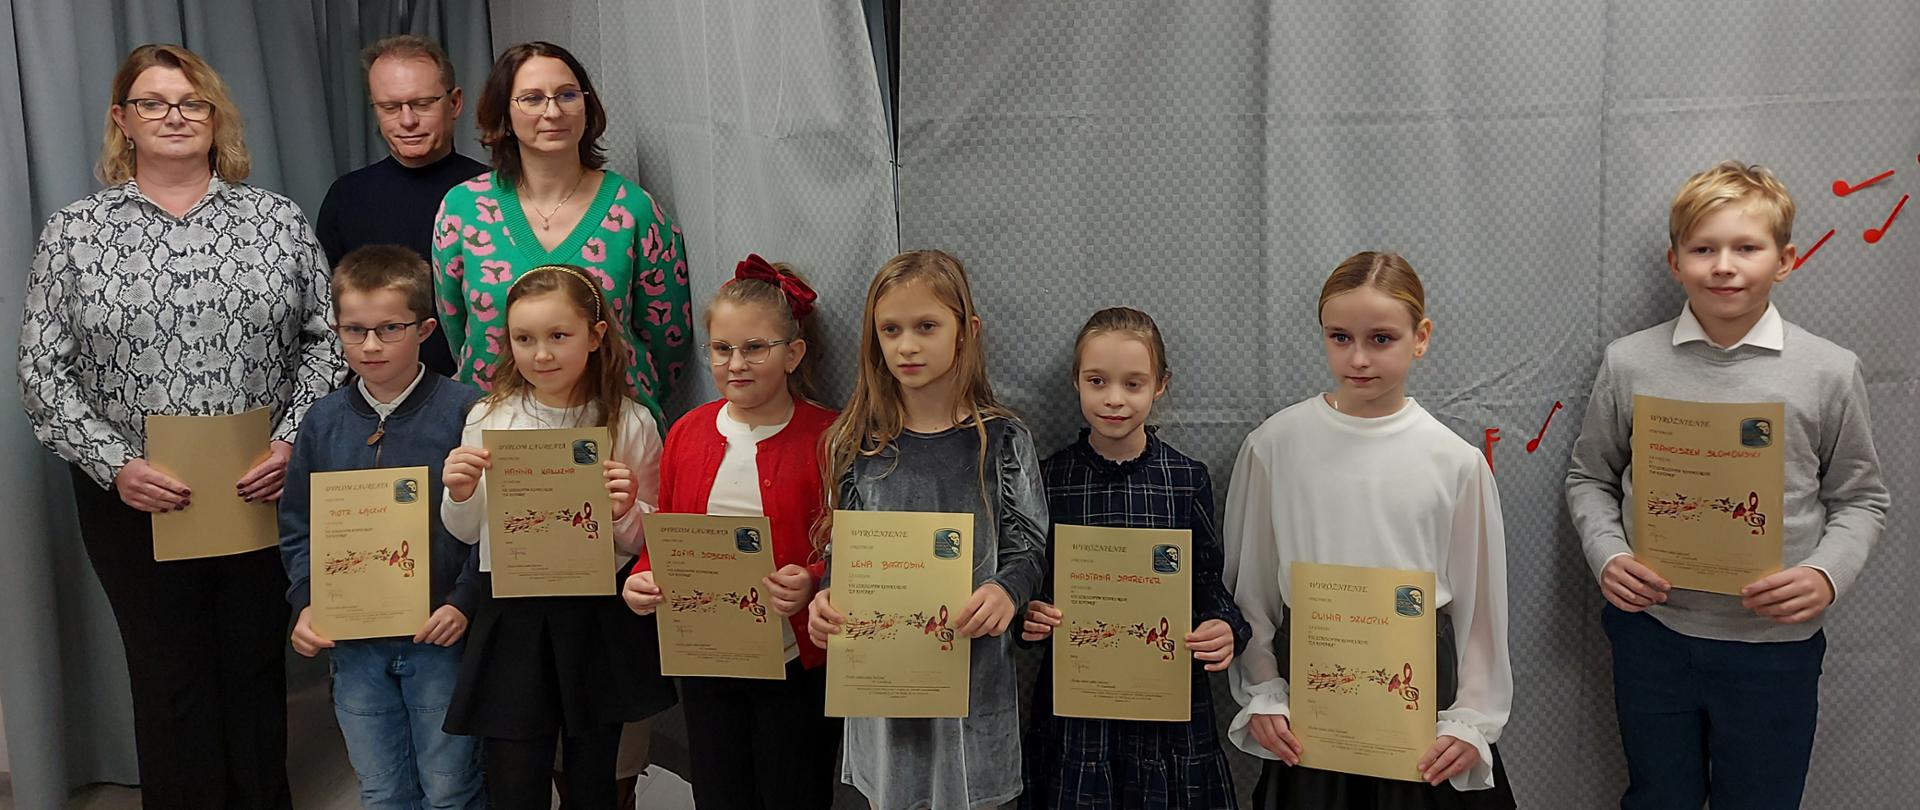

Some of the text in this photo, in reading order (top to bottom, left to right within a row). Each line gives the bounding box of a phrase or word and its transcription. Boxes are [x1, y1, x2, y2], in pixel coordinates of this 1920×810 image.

[504, 468, 533, 476] HANNA
[353, 482, 389, 491] LAUREATA
[691, 527, 729, 535] LAUREATA
[671, 549, 695, 557] ZOFIA
[851, 560, 873, 568] LENA
